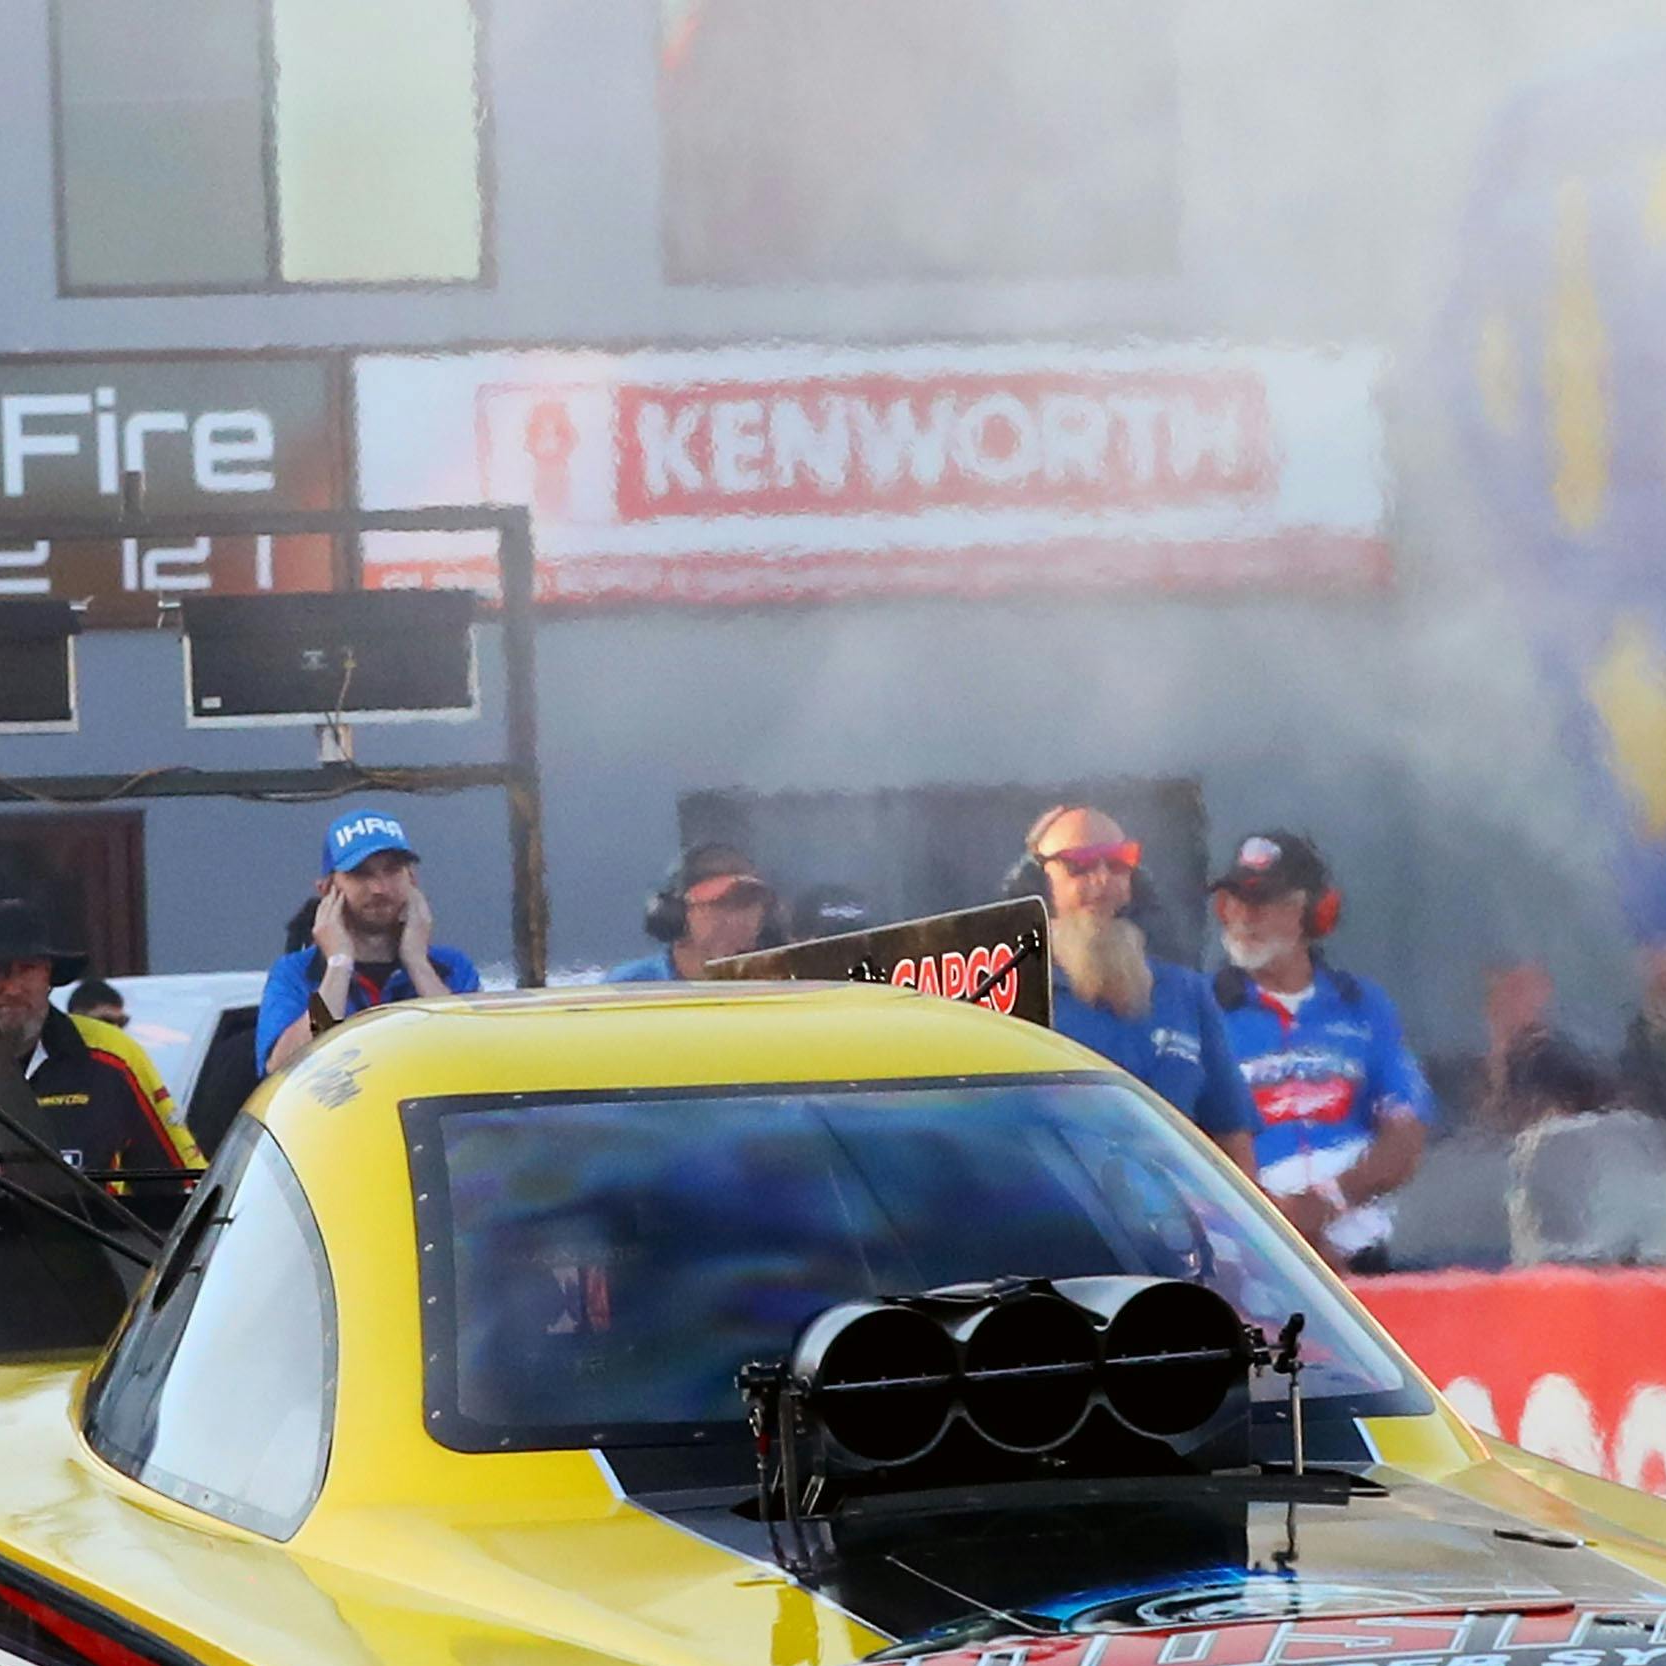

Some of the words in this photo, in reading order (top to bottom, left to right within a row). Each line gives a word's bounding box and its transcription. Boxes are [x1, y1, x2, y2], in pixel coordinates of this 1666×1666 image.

[0, 386, 275, 497] Fire
[637, 392, 1241, 496] KENWORTH
[335, 817, 404, 847] IHRA
